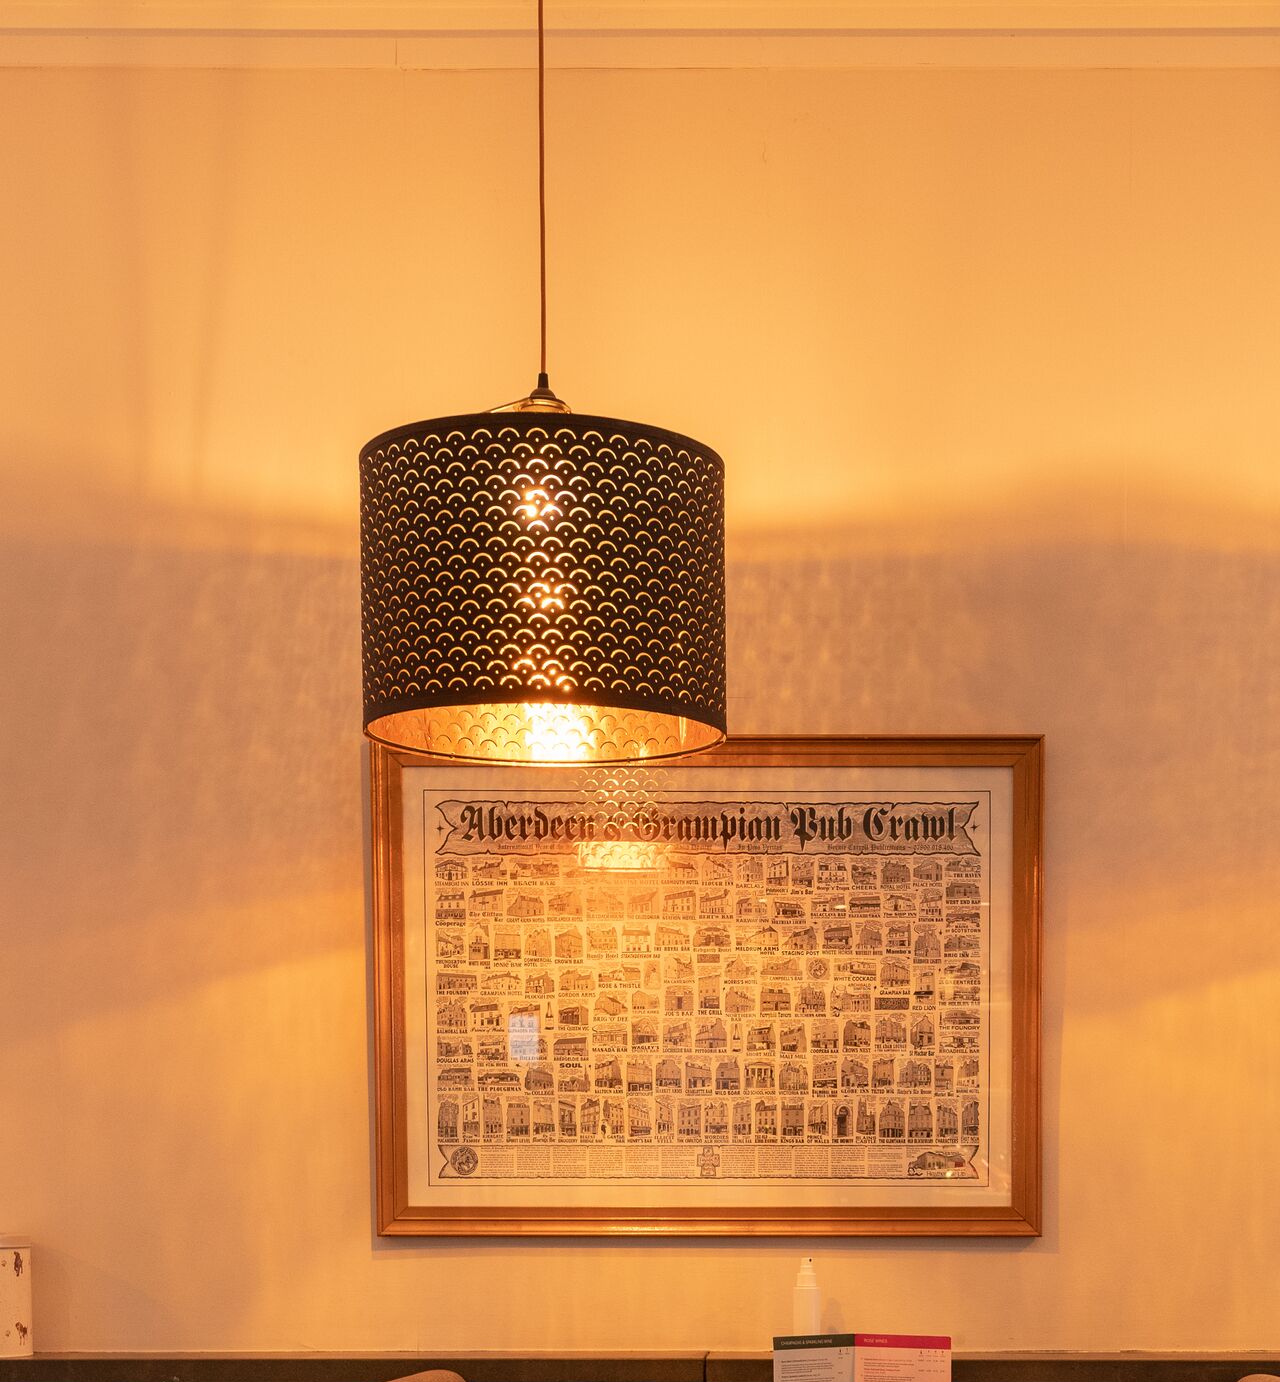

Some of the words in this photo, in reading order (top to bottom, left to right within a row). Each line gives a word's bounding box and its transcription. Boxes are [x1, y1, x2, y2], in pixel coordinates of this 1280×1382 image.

[460, 804, 596, 842] Aberdeen
[634, 805, 782, 853] Grampian
[790, 806, 852, 853] Pub
[862, 806, 956, 842] Crawl
